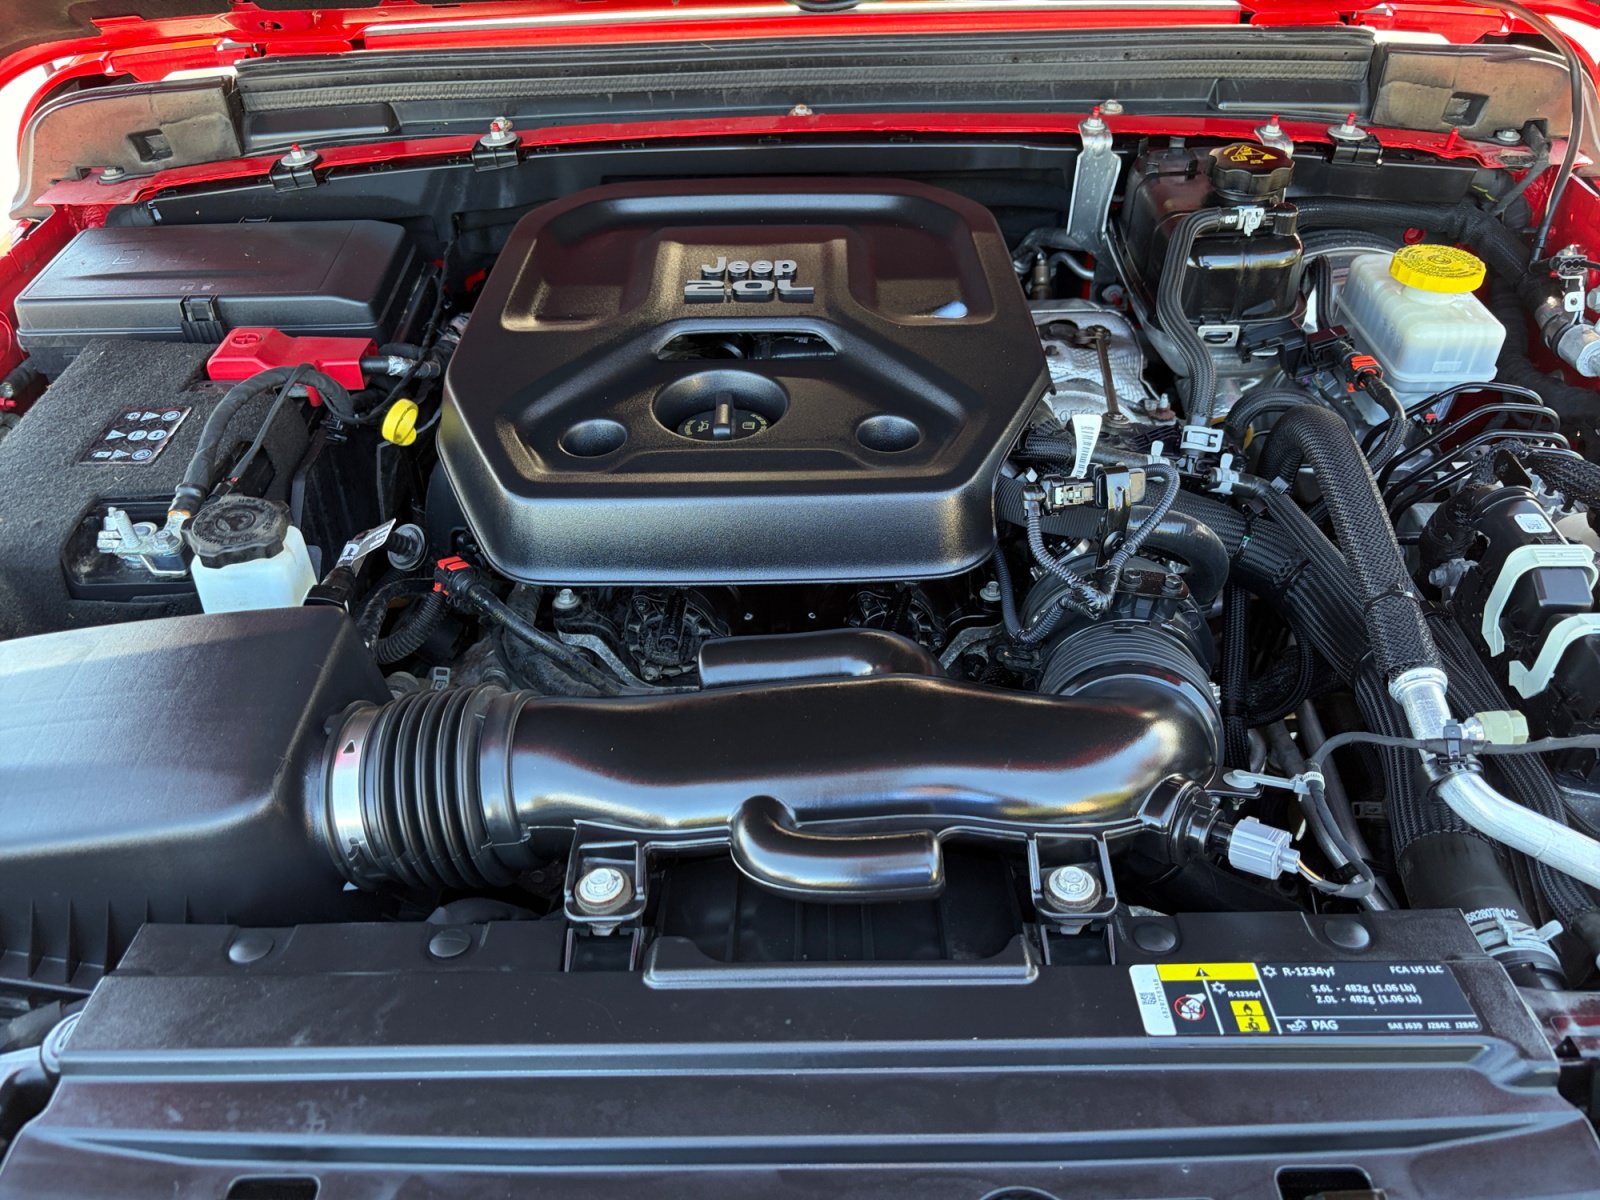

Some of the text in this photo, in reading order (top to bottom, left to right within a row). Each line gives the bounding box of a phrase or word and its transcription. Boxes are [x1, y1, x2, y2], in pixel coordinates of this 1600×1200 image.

[701, 256, 797, 281] Jeep
[684, 279, 814, 304] 2.0L
[1282, 966, 1335, 978] R-1234yf
[1389, 965, 1444, 974] FCA US LLC
[1310, 984, 1333, 993] 3.6L
[1344, 984, 1370, 994] 482g
[1372, 984, 1399, 994] (1.06
[1315, 995, 1338, 1004] 2.0L
[1349, 995, 1376, 1005] 482g
[1378, 995, 1405, 1005] (1.06
[1311, 1020, 1339, 1031] PAG
